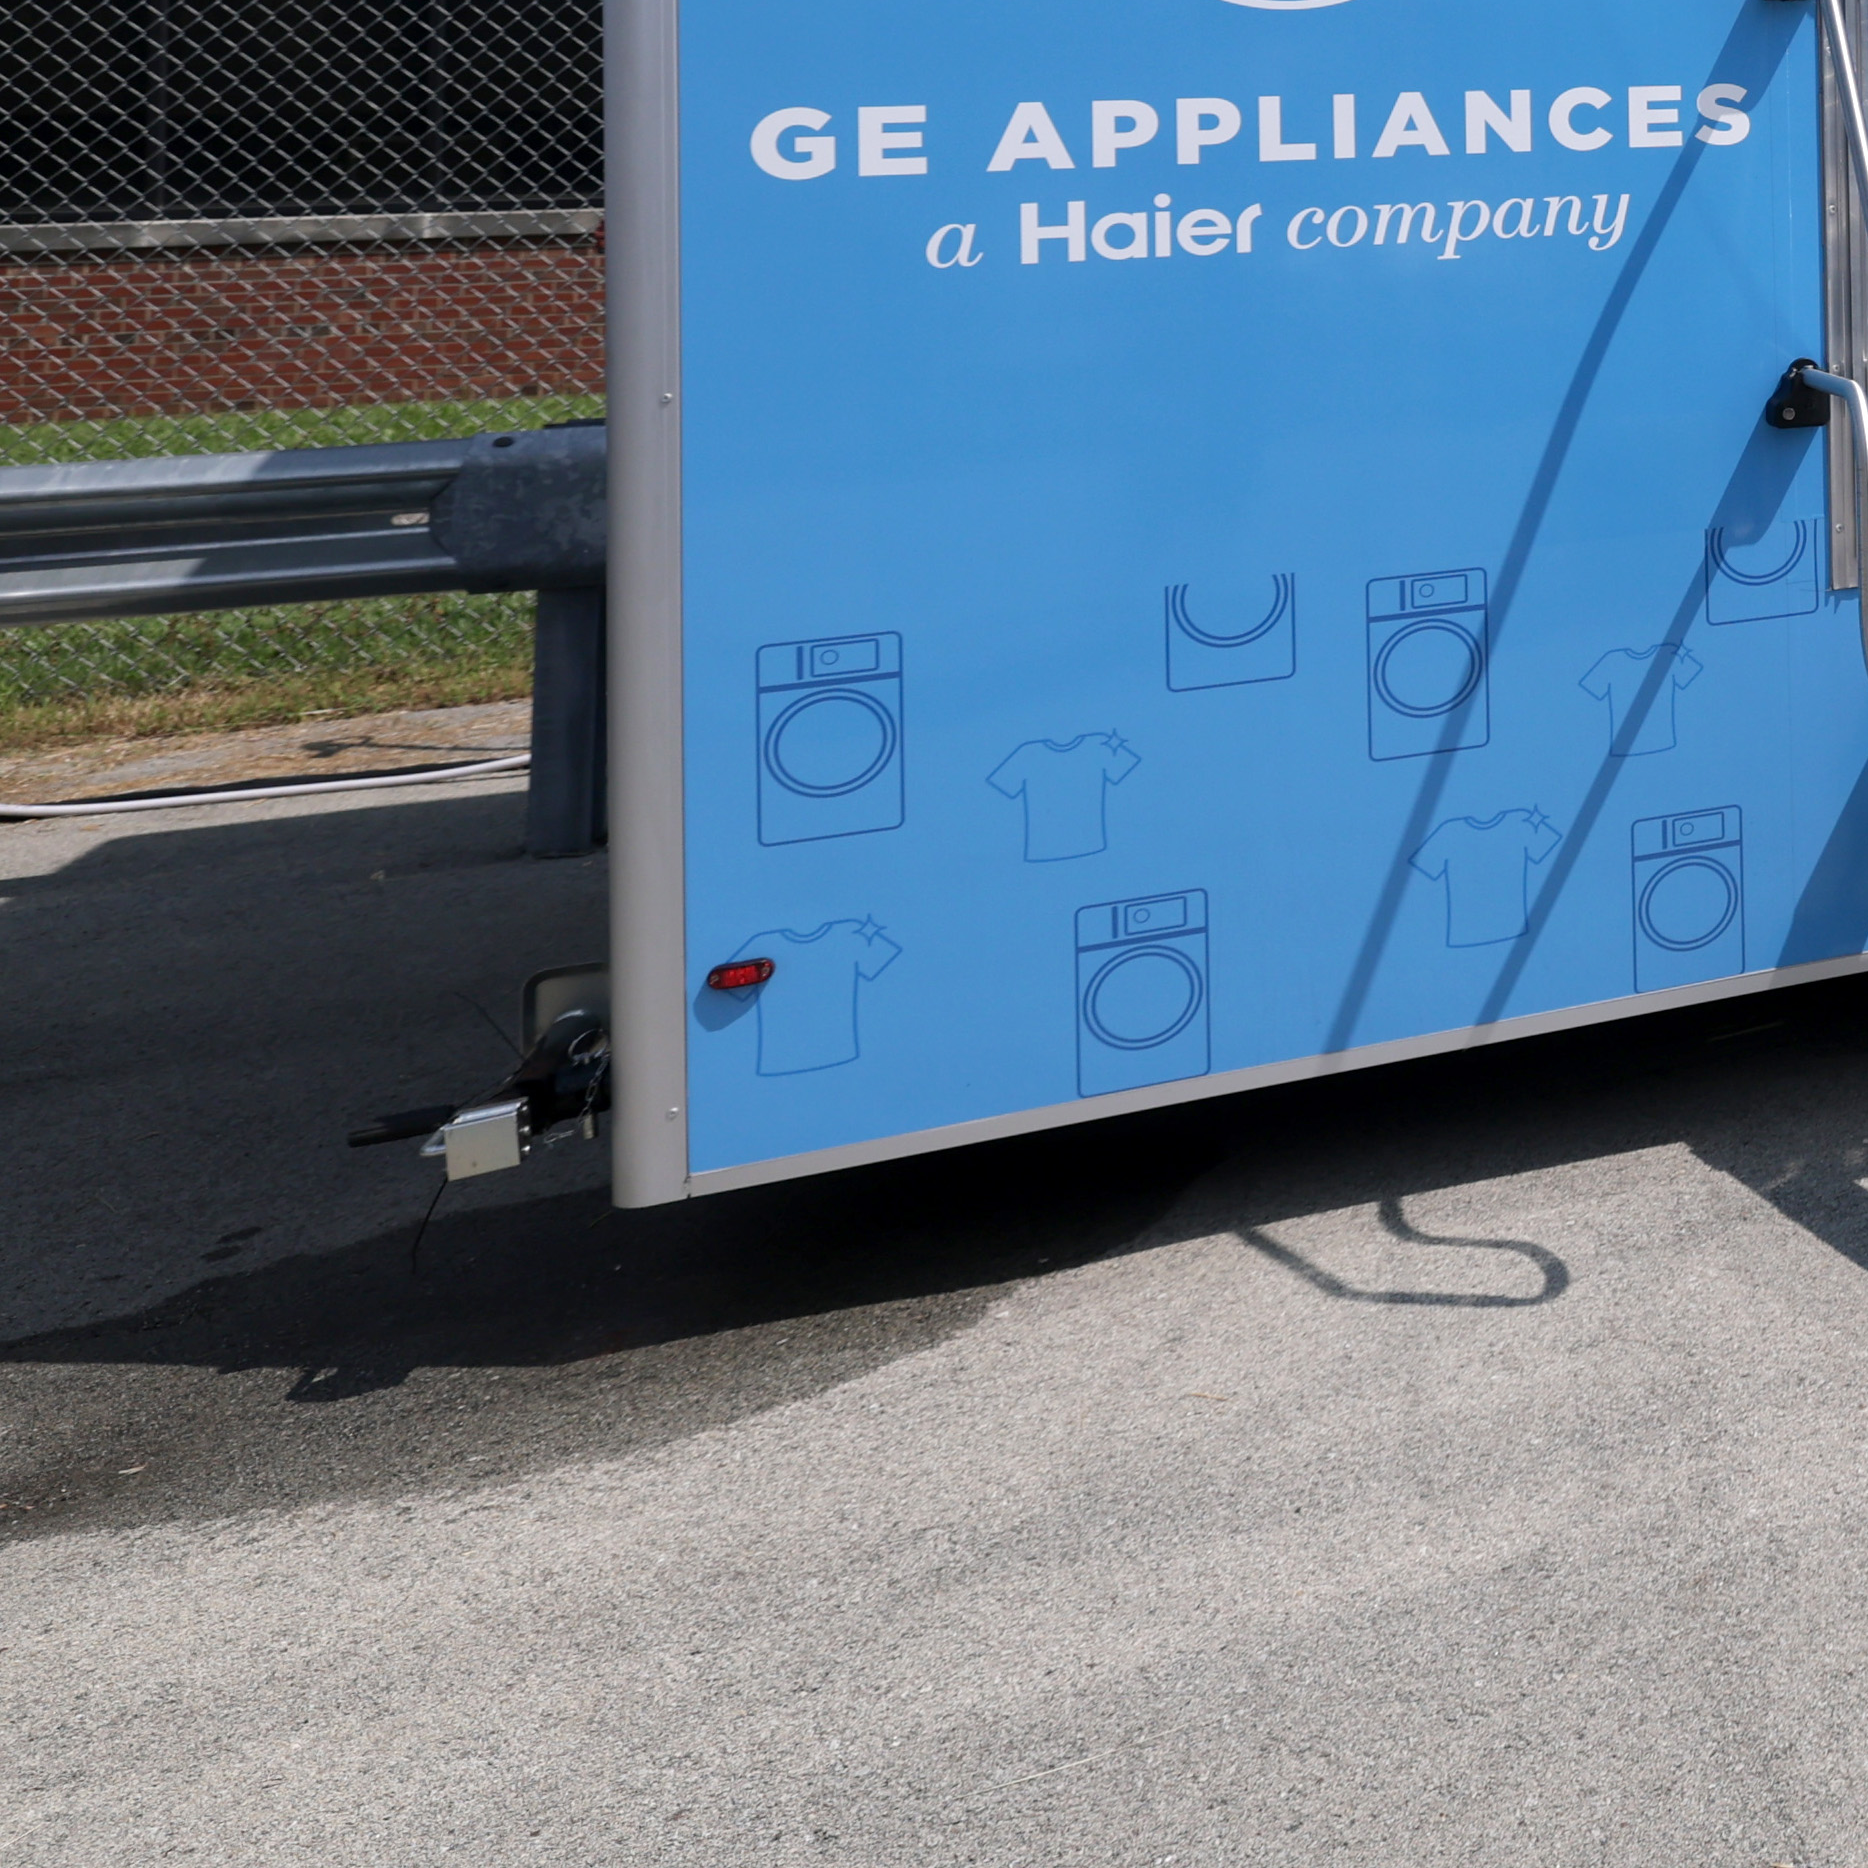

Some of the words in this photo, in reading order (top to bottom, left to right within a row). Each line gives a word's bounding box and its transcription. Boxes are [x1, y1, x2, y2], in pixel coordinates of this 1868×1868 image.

[750, 104, 928, 181] GE
[986, 83, 1751, 172] APPLIANCES
[925, 223, 984, 269] a
[1020, 193, 1263, 265] Haier
[1286, 193, 1631, 262] company
